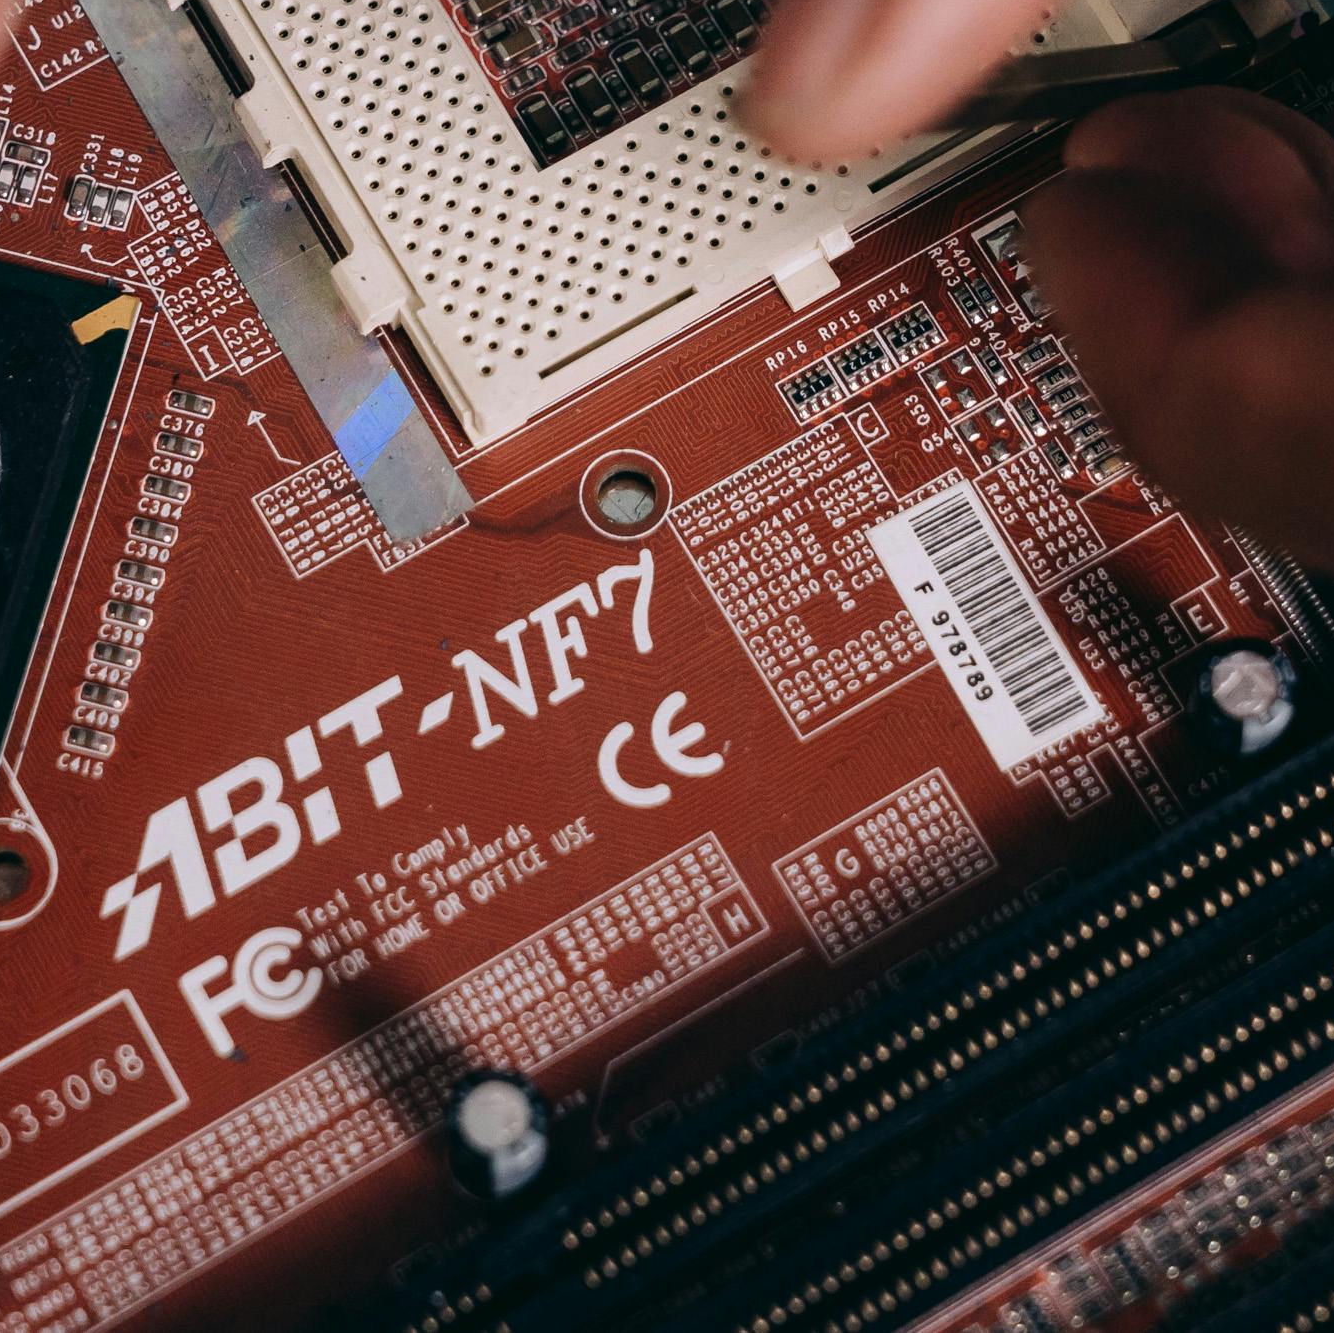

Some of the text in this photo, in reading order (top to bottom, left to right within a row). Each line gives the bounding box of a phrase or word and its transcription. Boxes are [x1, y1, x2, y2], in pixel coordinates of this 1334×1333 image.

[27, 24, 42, 51] J
[40, 48, 84, 78] C142
[79, 133, 106, 173] C331
[103, 147, 125, 180] L18
[38, 172, 59, 204] L17
[156, 181, 187, 221] FB57
[185, 218, 212, 252] D22
[928, 246, 961, 287] R403
[945, 237, 976, 277] R401
[196, 276, 227, 317] C212
[211, 266, 244, 307] R237
[163, 294, 195, 335] C214
[765, 282, 911, 371] RP16 RP15 RP14
[239, 316, 272, 357] C217
[980, 321, 1013, 361] R407
[160, 414, 205, 438] C376
[820, 422, 851, 464] C311
[856, 412, 879, 438] C
[149, 456, 194, 479] C380
[776, 447, 809, 488] C304
[791, 438, 824, 482] C312
[805, 430, 838, 473] C303
[997, 451, 1040, 483] R418
[290, 476, 318, 508] C37
[733, 471, 766, 514] C305
[747, 464, 780, 506] C314
[762, 456, 794, 497] C313
[842, 469, 874, 511] R341
[857, 460, 889, 502] R340
[1006, 463, 1049, 495] R424
[1016, 478, 1060, 511] R432
[686, 498, 718, 537] C307
[702, 488, 734, 530] C315
[718, 481, 750, 521] C306
[814, 487, 846, 528] C328
[829, 478, 861, 518] C327
[984, 481, 1019, 525] R435
[1026, 495, 1069, 527] R443
[671, 507, 704, 546] C316
[696, 496, 815, 571] C325 C324 RT1
[794, 522, 828, 565] R350
[1036, 509, 1079, 541] R448
[1045, 524, 1088, 557] R455
[706, 530, 793, 588] C334 C333
[717, 546, 803, 603] C339 C338
[1019, 537, 1052, 581] R451
[1056, 539, 1098, 570] C445
[110, 581, 156, 604] C394
[725, 562, 811, 619] C345 C344
[823, 569, 856, 612] C348
[1067, 567, 1109, 599] C428
[1077, 582, 1117, 612] R426
[736, 578, 821, 636] C351 C350
[1087, 596, 1130, 629] R433
[1187, 604, 1215, 634] E
[749, 635, 783, 680] C355
[914, 580, 993, 701] F 978789
[1078, 637, 1107, 671] U33
[85, 663, 132, 686] C402
[597, 690, 725, 809] CE
[1067, 754, 1102, 798] FB68
[295, 823, 470, 933] Test To Comply
[835, 848, 861, 879] G
[309, 823, 533, 960] With FCC Standards
[326, 815, 596, 988] FOR HOME OR OFFICE USE
[723, 902, 751, 937] H
